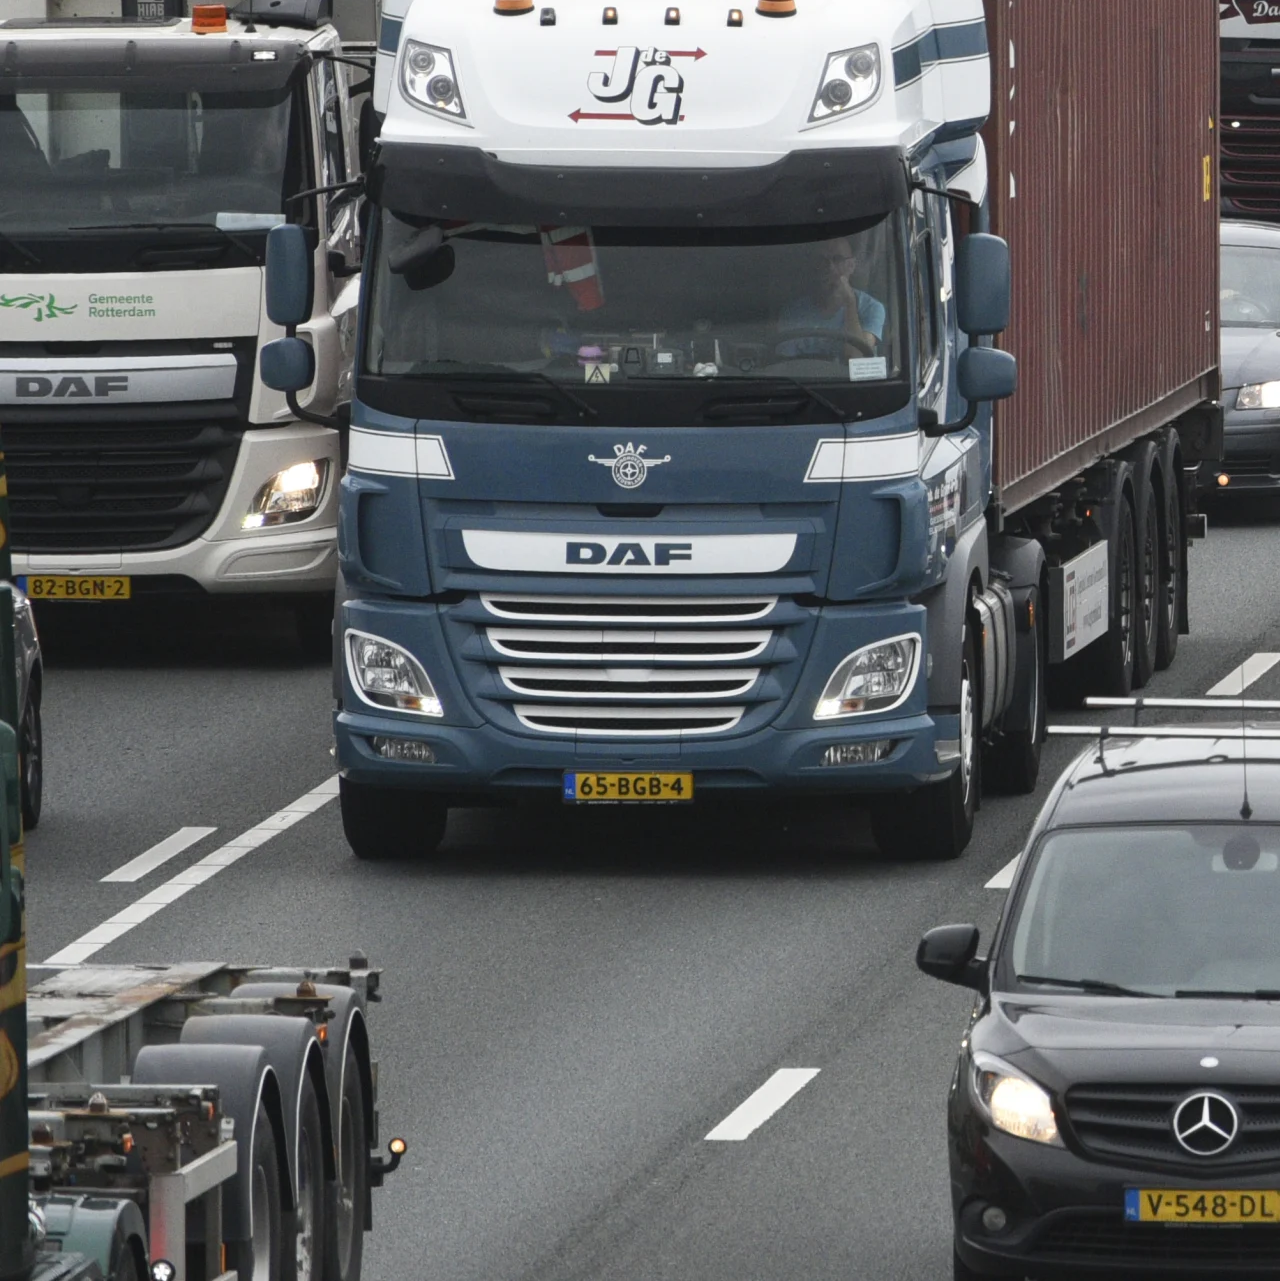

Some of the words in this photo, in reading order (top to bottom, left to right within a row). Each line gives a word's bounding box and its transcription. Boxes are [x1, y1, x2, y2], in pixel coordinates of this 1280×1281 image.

[137, 3, 164, 16] HIAB
[641, 47, 671, 64] de
[88, 293, 153, 304] Gemeente
[89, 306, 155, 317] Rotterdam
[15, 375, 129, 398] DAF
[613, 442, 647, 456] DAF
[565, 541, 693, 566] DAF
[34, 579, 126, 596] 82-BGN-2
[580, 777, 685, 796] 65-BGB-4
[1148, 1194, 1274, 1218] V-548-DL
